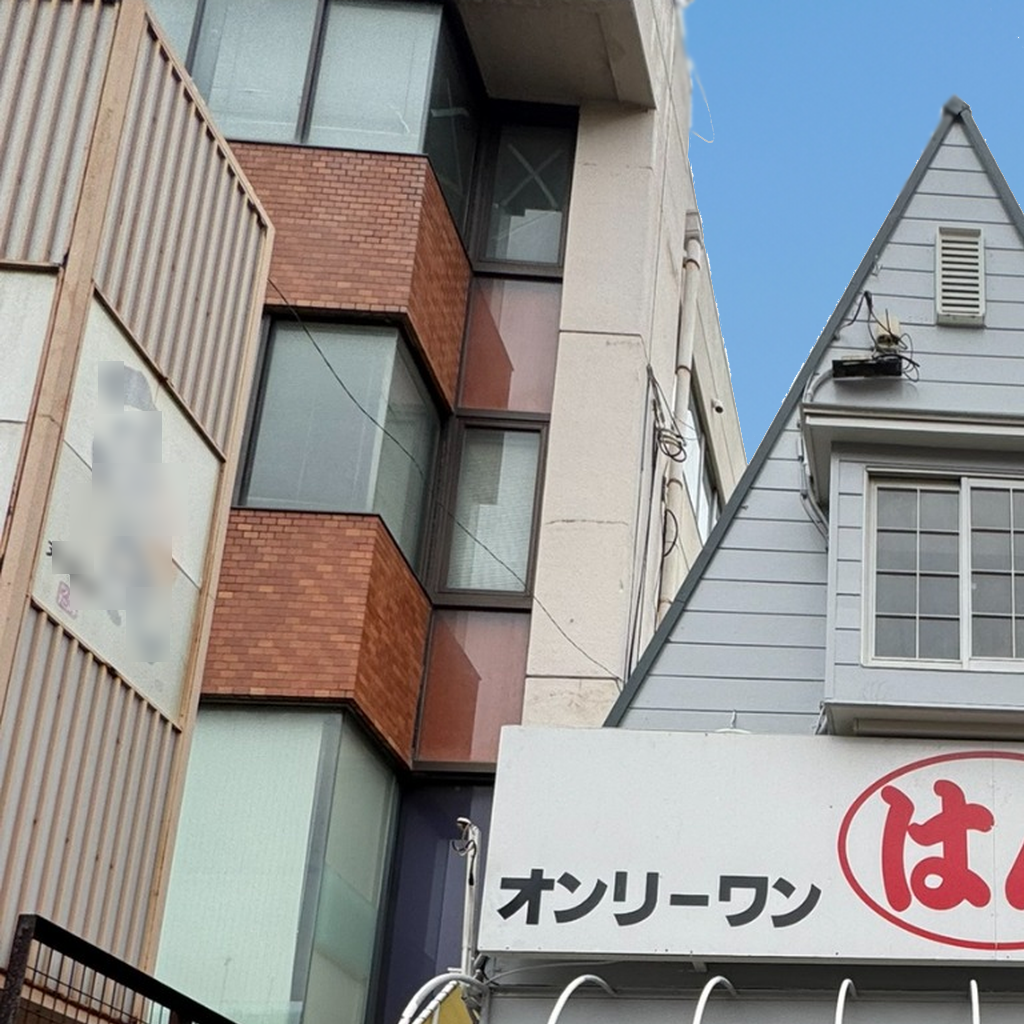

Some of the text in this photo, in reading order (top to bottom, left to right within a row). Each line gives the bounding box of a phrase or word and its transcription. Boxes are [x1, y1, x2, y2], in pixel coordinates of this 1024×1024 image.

[498, 869, 821, 927] オンリーワン
